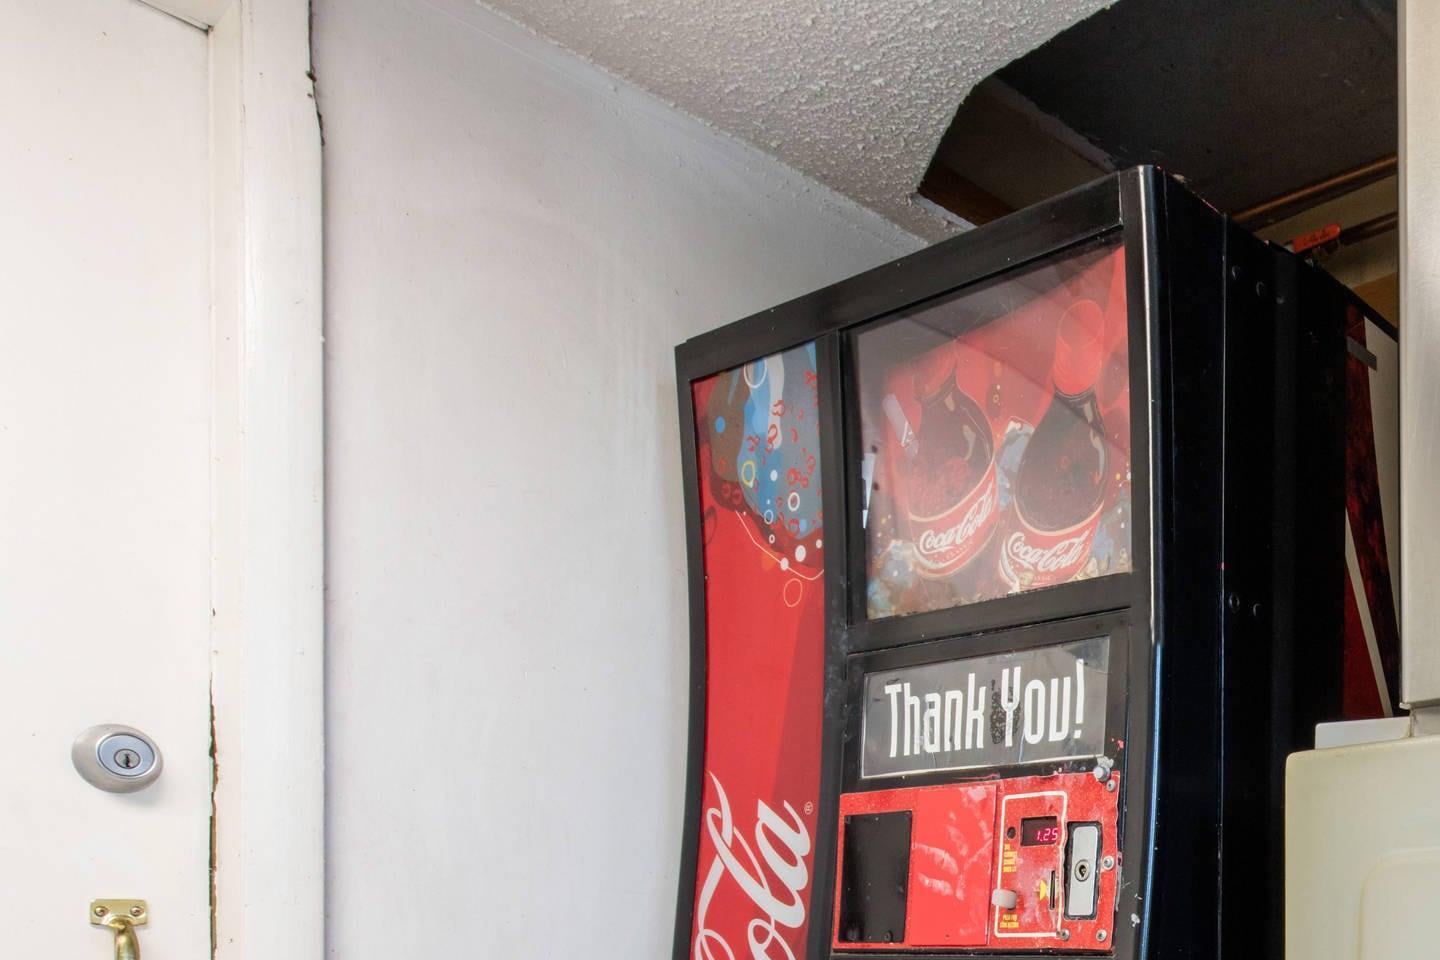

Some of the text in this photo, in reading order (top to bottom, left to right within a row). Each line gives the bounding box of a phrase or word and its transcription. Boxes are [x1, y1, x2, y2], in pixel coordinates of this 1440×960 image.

[884, 658, 1085, 758] Thank You!
[1036, 827, 1058, 842] 1.25
